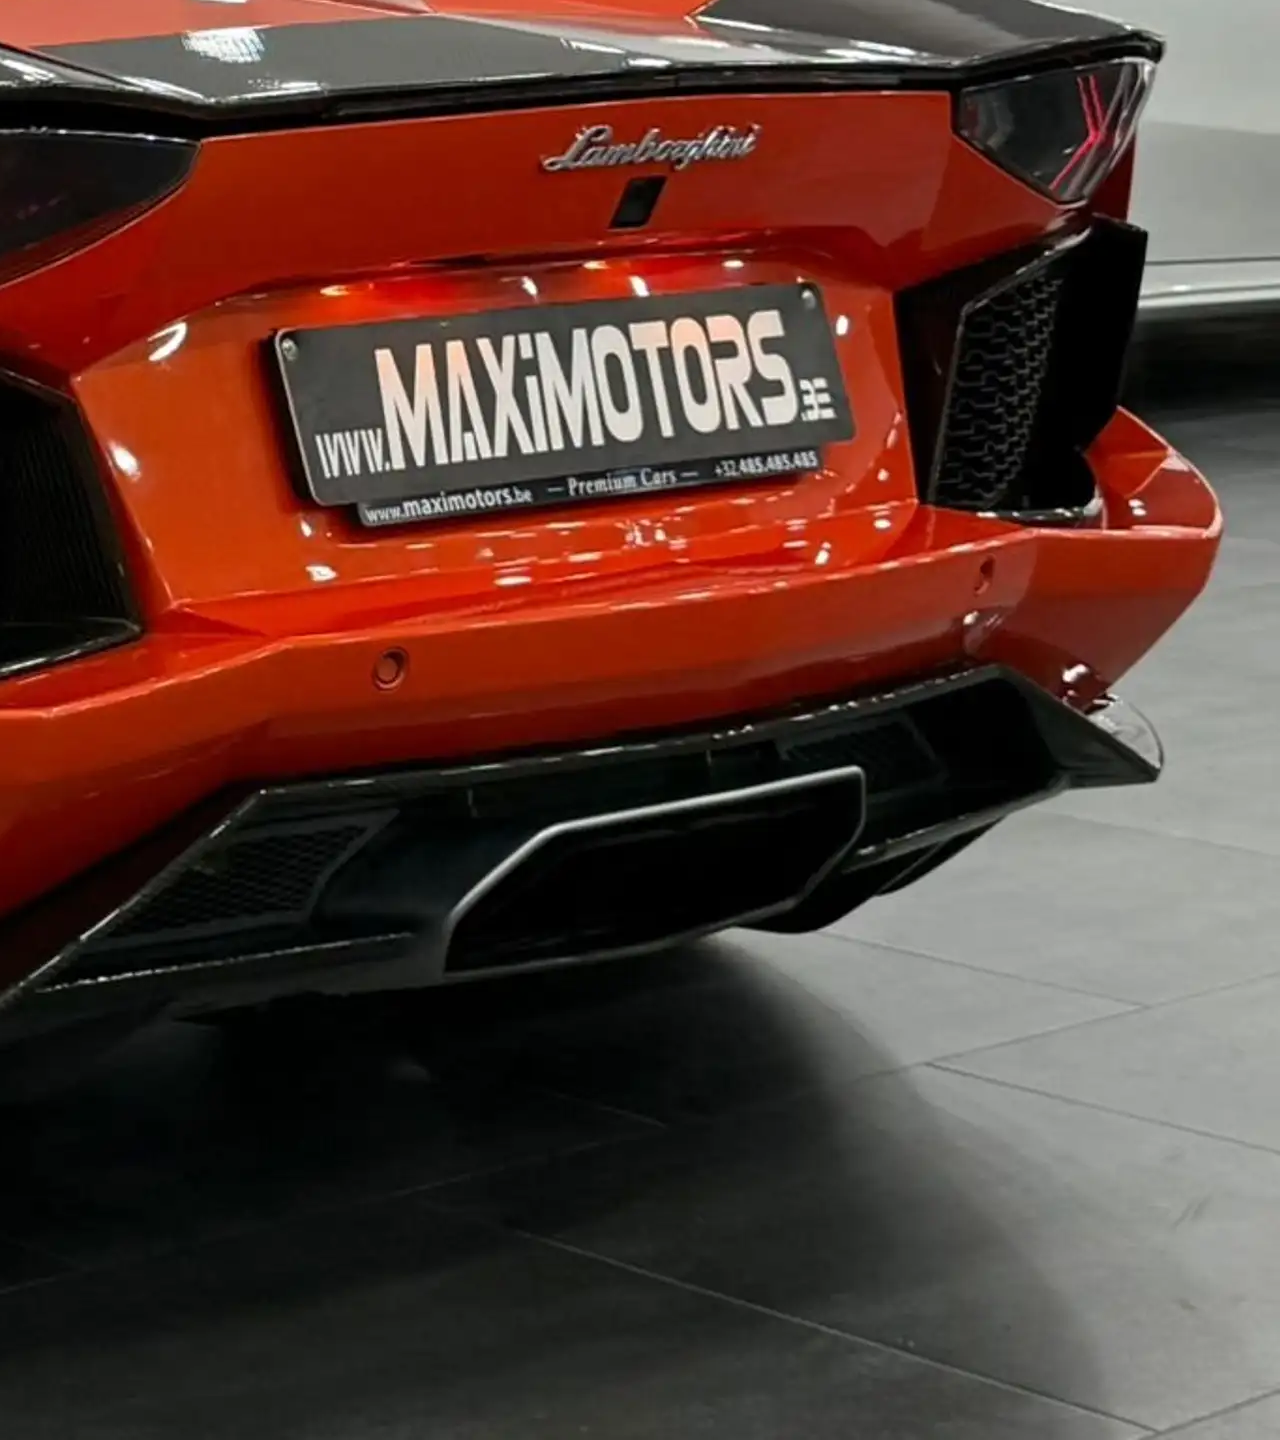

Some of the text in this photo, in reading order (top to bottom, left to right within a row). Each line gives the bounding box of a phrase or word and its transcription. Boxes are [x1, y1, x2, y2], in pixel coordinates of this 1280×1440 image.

[541, 122, 764, 172] Lamborghini
[364, 486, 534, 523] www.maximotors.be
[567, 472, 638, 497] Premium
[640, 457, 677, 486] Cars
